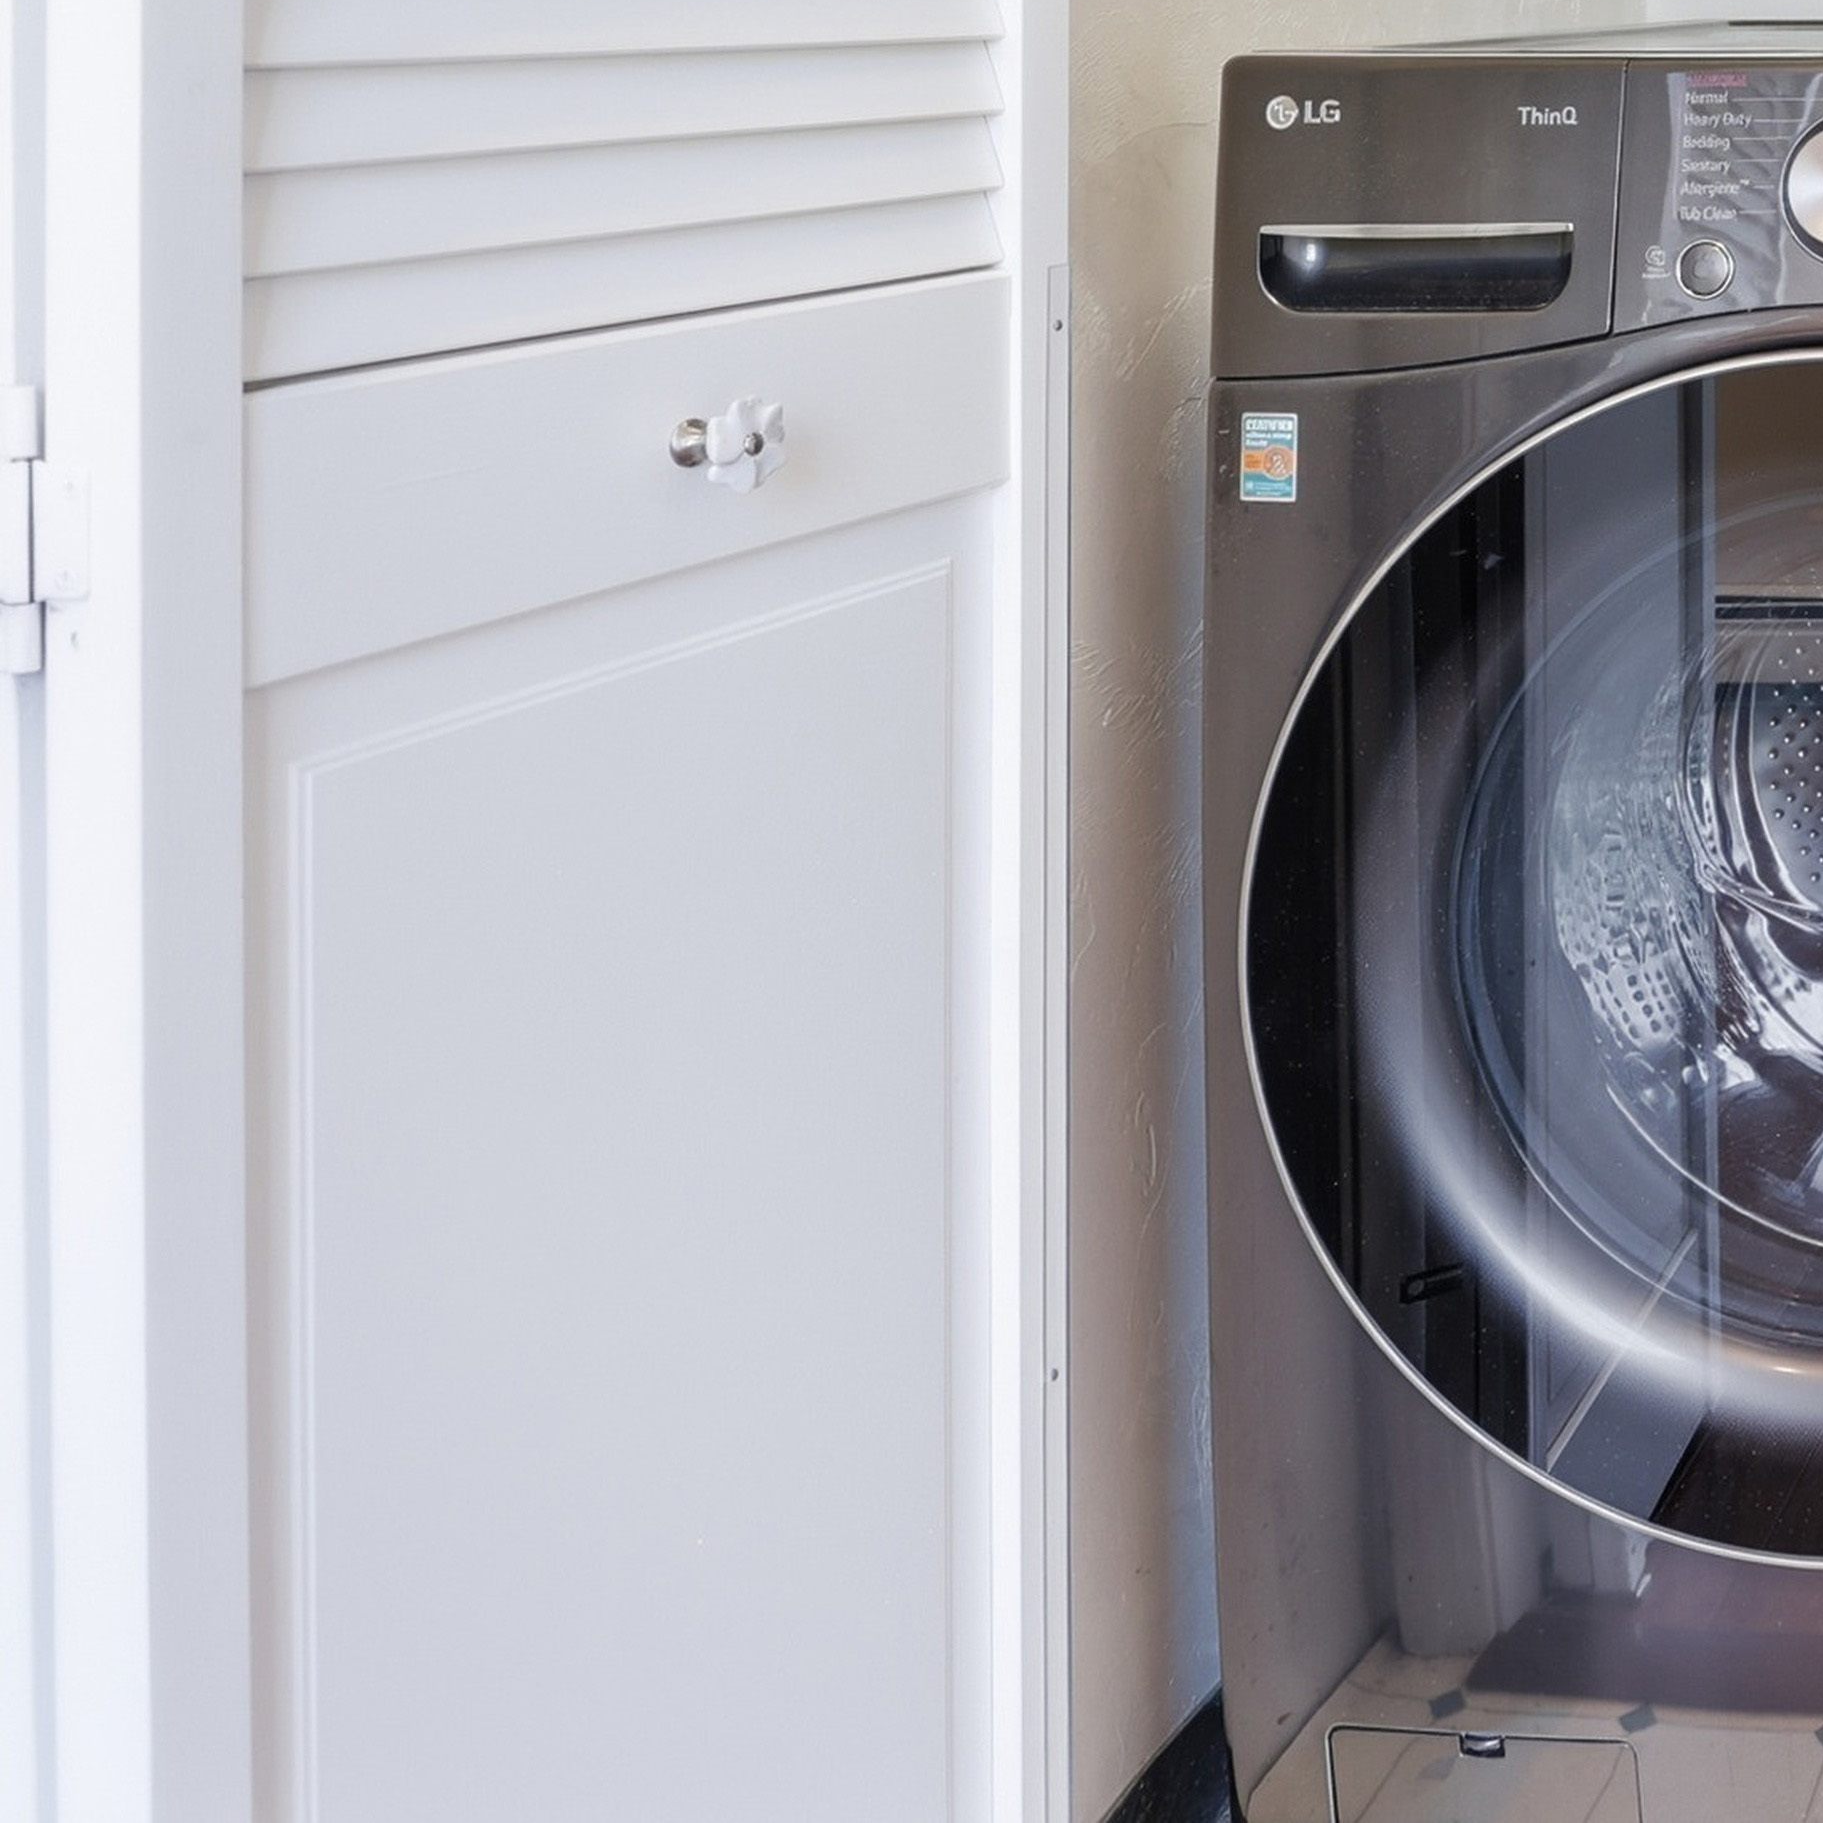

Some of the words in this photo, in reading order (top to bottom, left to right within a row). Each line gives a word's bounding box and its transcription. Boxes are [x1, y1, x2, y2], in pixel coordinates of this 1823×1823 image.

[1685, 91, 1729, 104] Normal
[1303, 99, 1341, 124] LG
[1517, 106, 1578, 126] ThinQ
[1684, 113, 1719, 128] Heavy
[1722, 112, 1752, 127] Duty
[1682, 135, 1731, 151] Bedding
[1681, 158, 1730, 173] Sanitary
[1703, 206, 1738, 221] Clean
